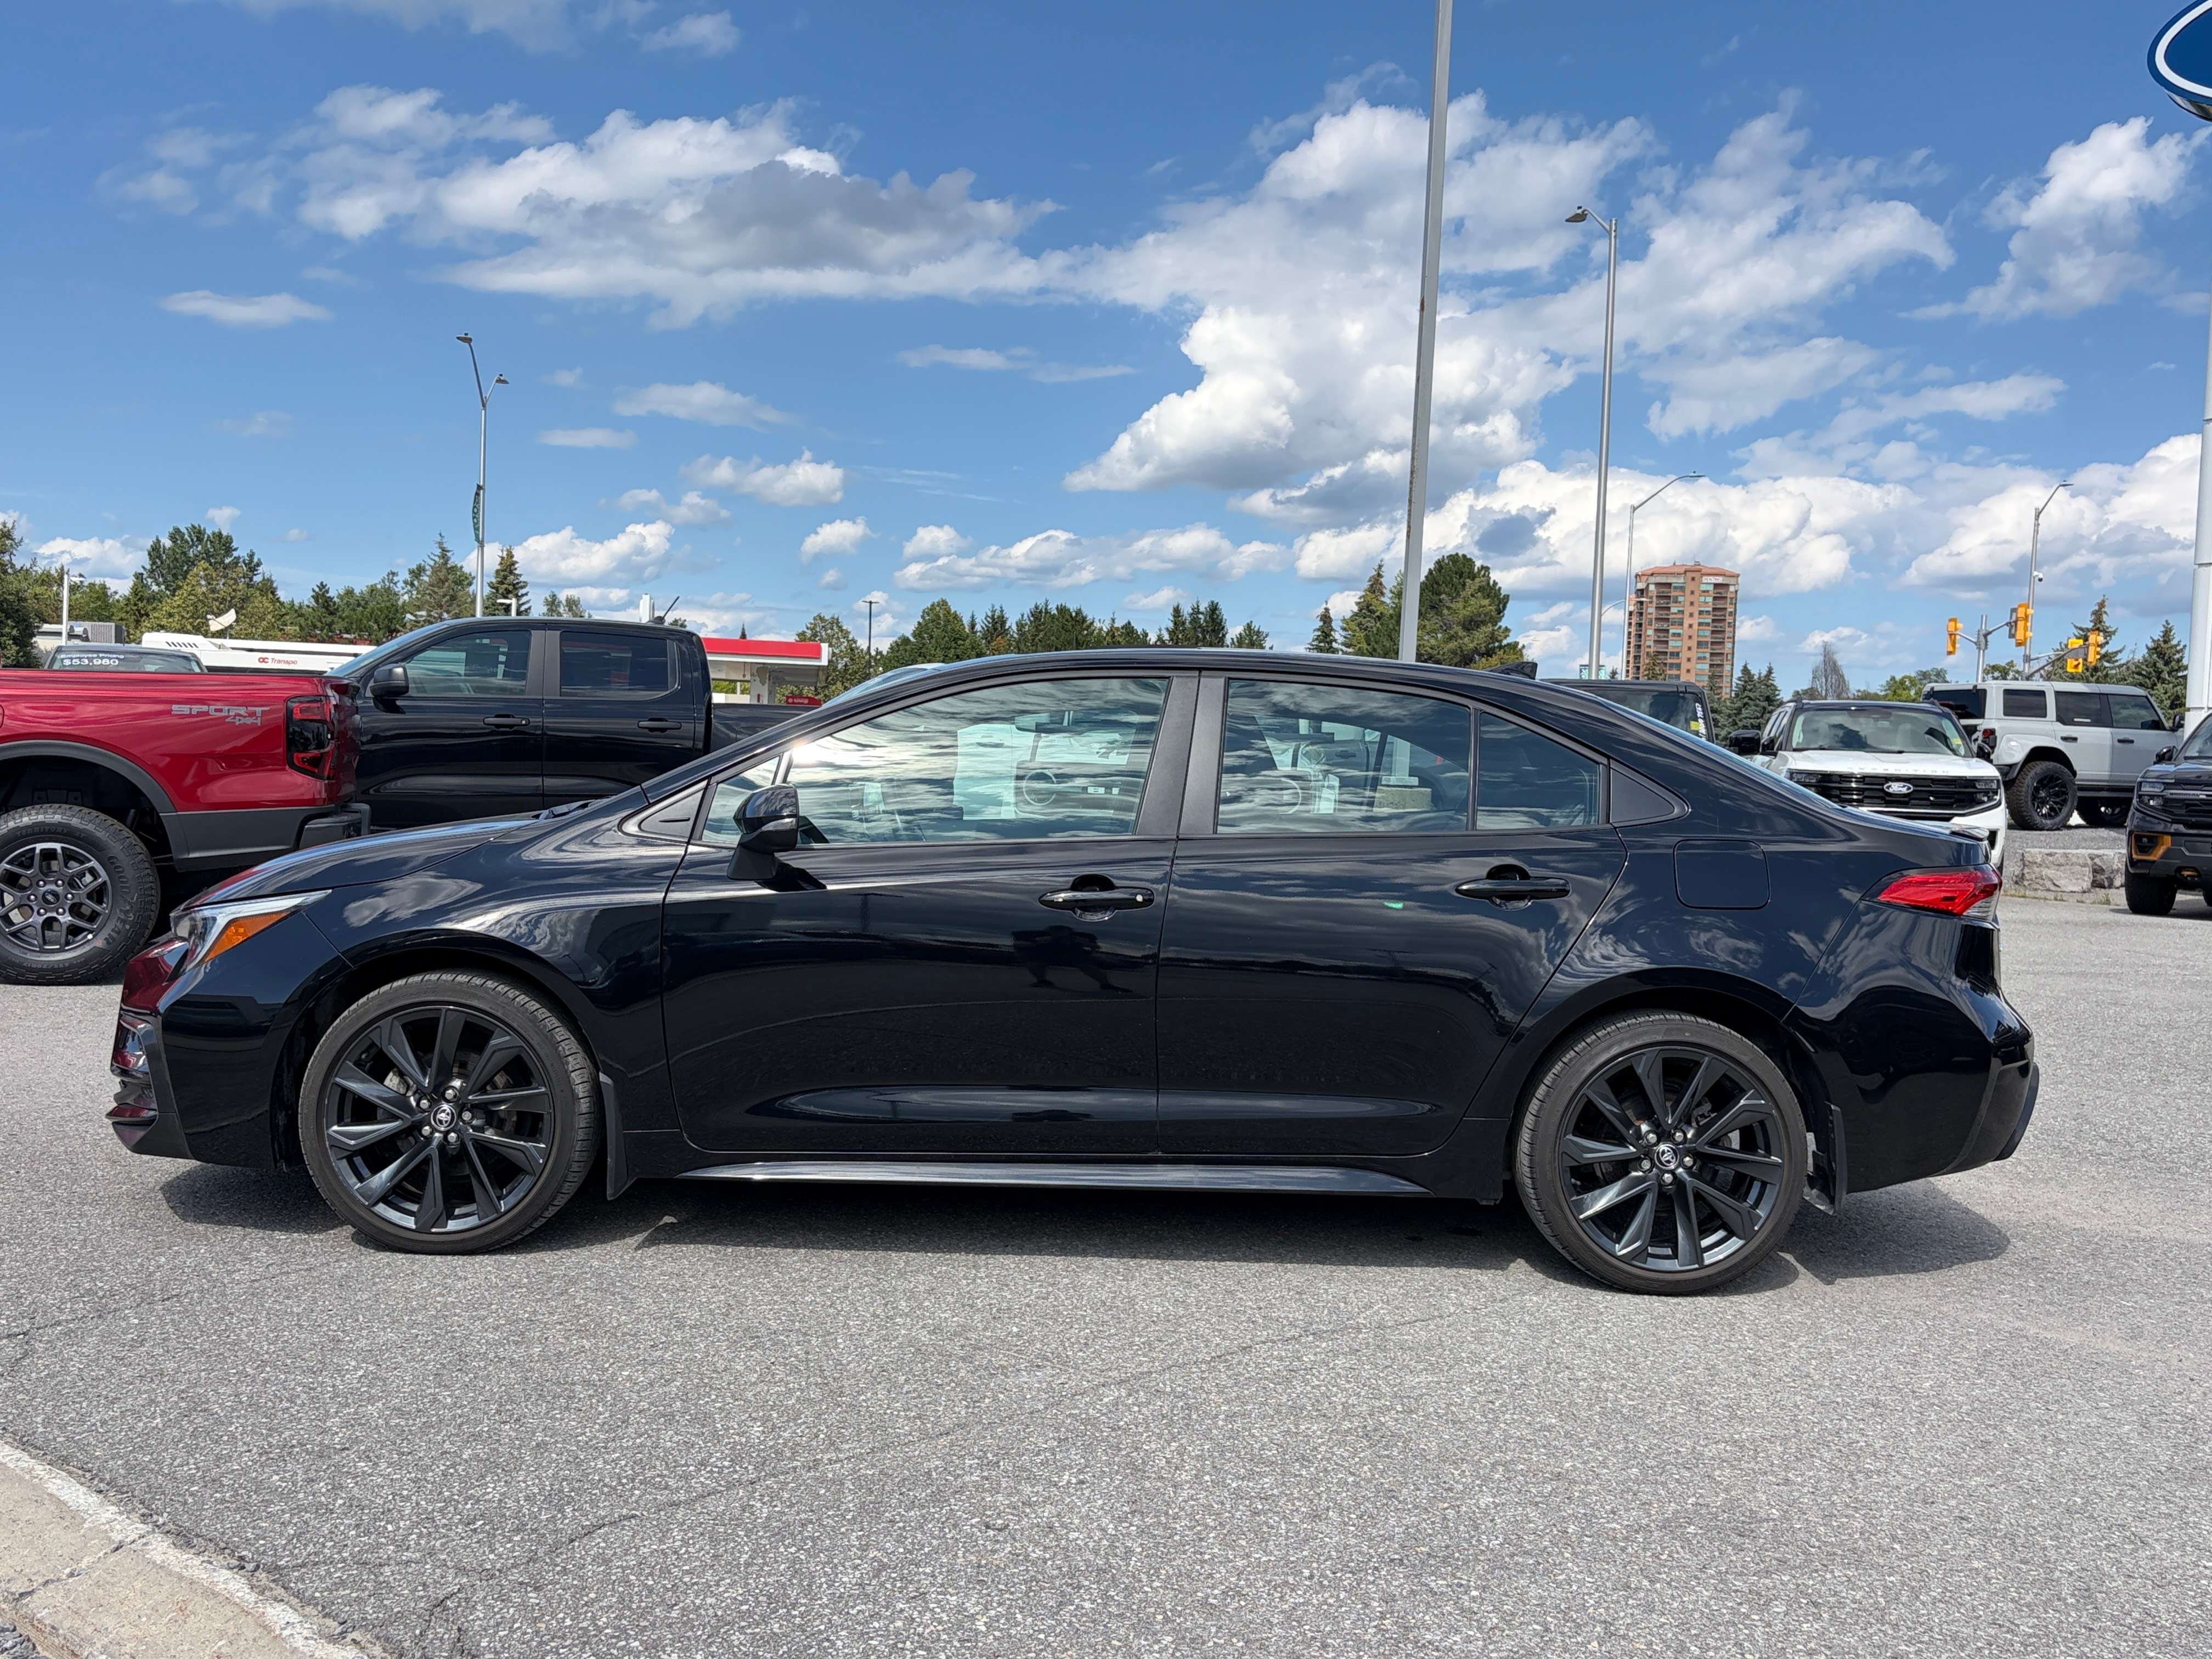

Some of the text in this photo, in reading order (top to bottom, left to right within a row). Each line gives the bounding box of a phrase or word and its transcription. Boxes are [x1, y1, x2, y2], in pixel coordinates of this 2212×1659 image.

[271, 658, 298, 666] Transpo
[171, 704, 272, 716] SPORT
[16, 827, 69, 837] TERRITORY
